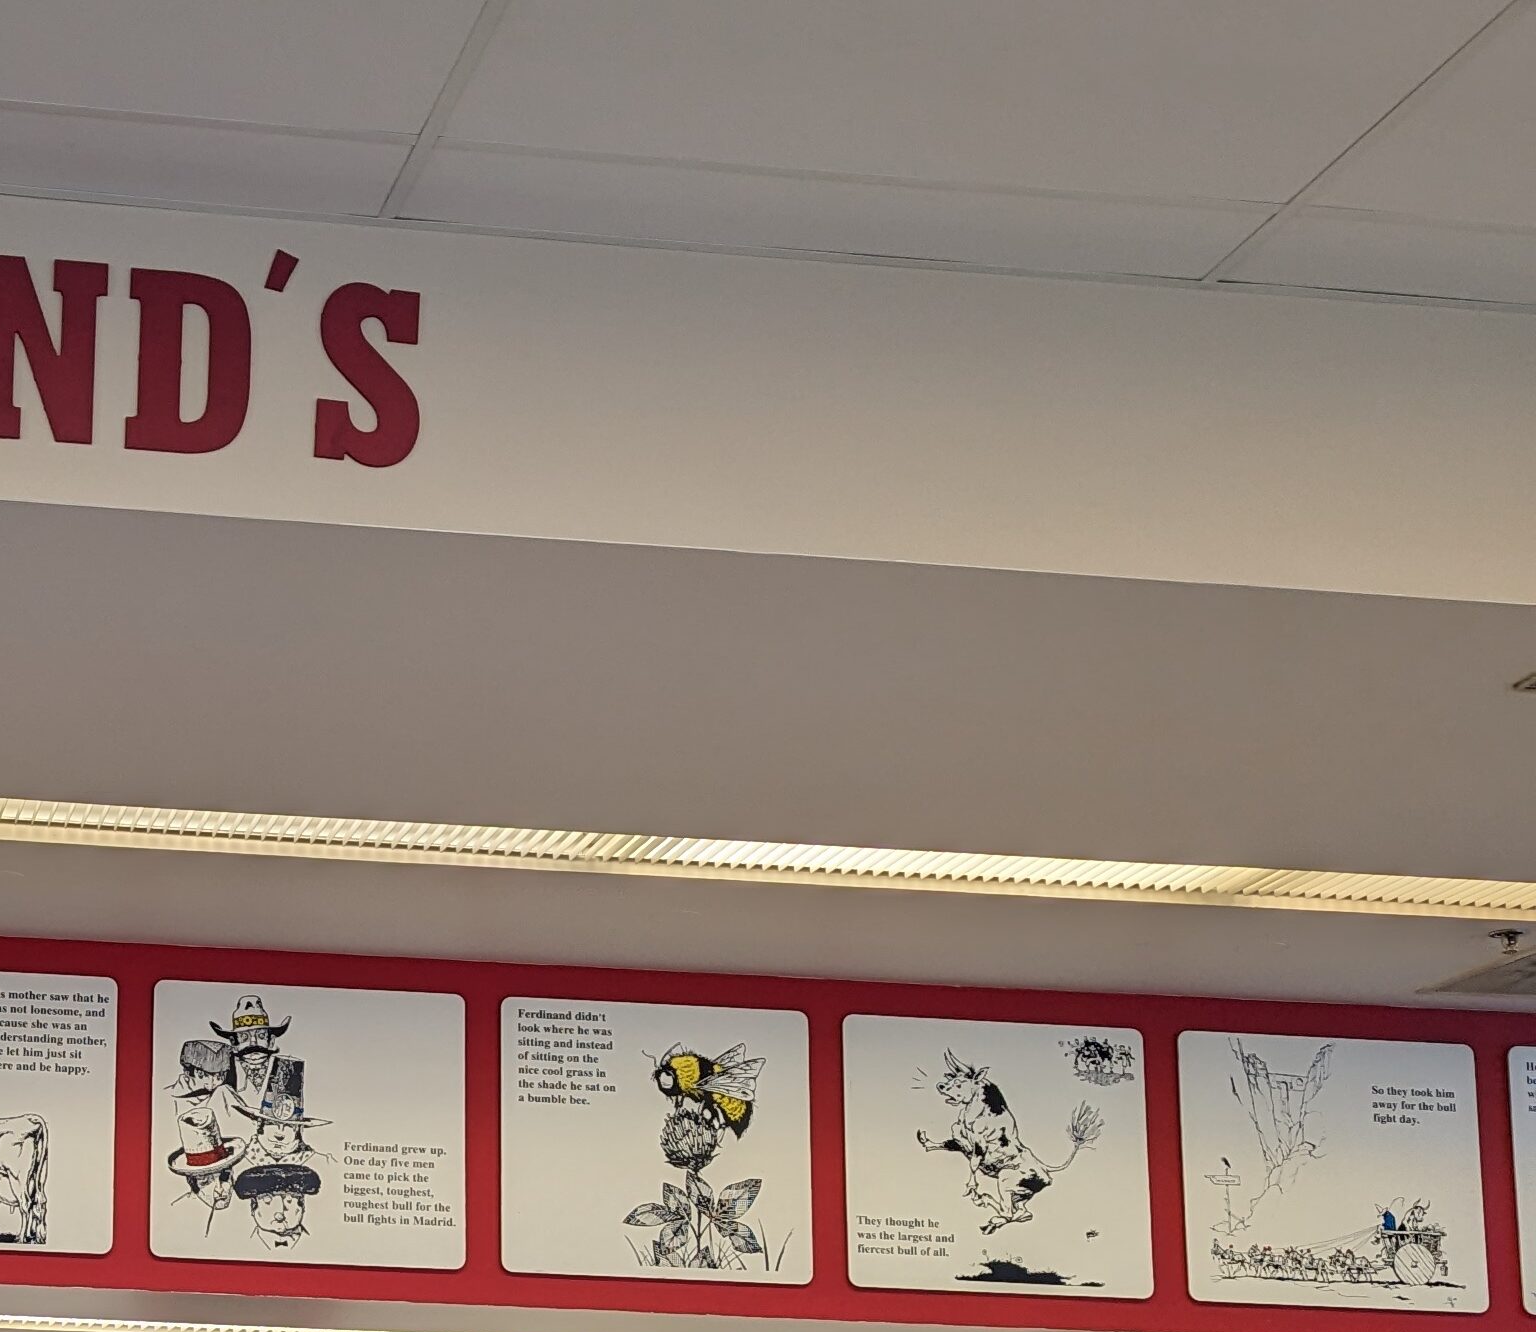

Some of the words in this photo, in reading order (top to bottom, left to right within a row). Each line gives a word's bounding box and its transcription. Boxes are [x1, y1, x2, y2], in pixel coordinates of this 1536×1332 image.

[9, 991, 47, 1000] mother
[72, 993, 94, 1002] that
[98, 994, 109, 1003] he
[31, 1005, 82, 1018] lonesome,
[85, 1008, 105, 1017] and
[518, 1009, 571, 1020] Ferdinand
[575, 1012, 606, 1021] didn't
[518, 1023, 540, 1032] look
[544, 1025, 574, 1034] where
[578, 1026, 589, 1035] he
[593, 1028, 612, 1036] was
[66, 1036, 107, 1047] mother,
[518, 1038, 551, 1049] sitting
[554, 1039, 572, 1048] and
[576, 1040, 613, 1050] instead
[1371, 1086, 1384, 1095] So
[1387, 1086, 1407, 1098] they
[1411, 1088, 1433, 1097] took
[1436, 1088, 1455, 1098] him
[1372, 1101, 1397, 1111] away
[1401, 1101, 1417, 1110] for
[1419, 1102, 1433, 1111] the
[1437, 1103, 1456, 1112] bull
[1374, 1113, 1397, 1124] fight
[1399, 1114, 1420, 1126] day.
[344, 1142, 398, 1152] Ferdinand
[402, 1146, 426, 1155] grew
[430, 1149, 446, 1157] up.
[344, 1184, 383, 1196] biggest,
[387, 1187, 434, 1198] toughest,
[856, 1216, 882, 1227] They
[886, 1217, 925, 1229] thought
[928, 1219, 939, 1228] he
[858, 1244, 894, 1254] fiercest
[898, 1246, 917, 1255] bull
[921, 1247, 930, 1256] of
[933, 1248, 949, 1257] all.
